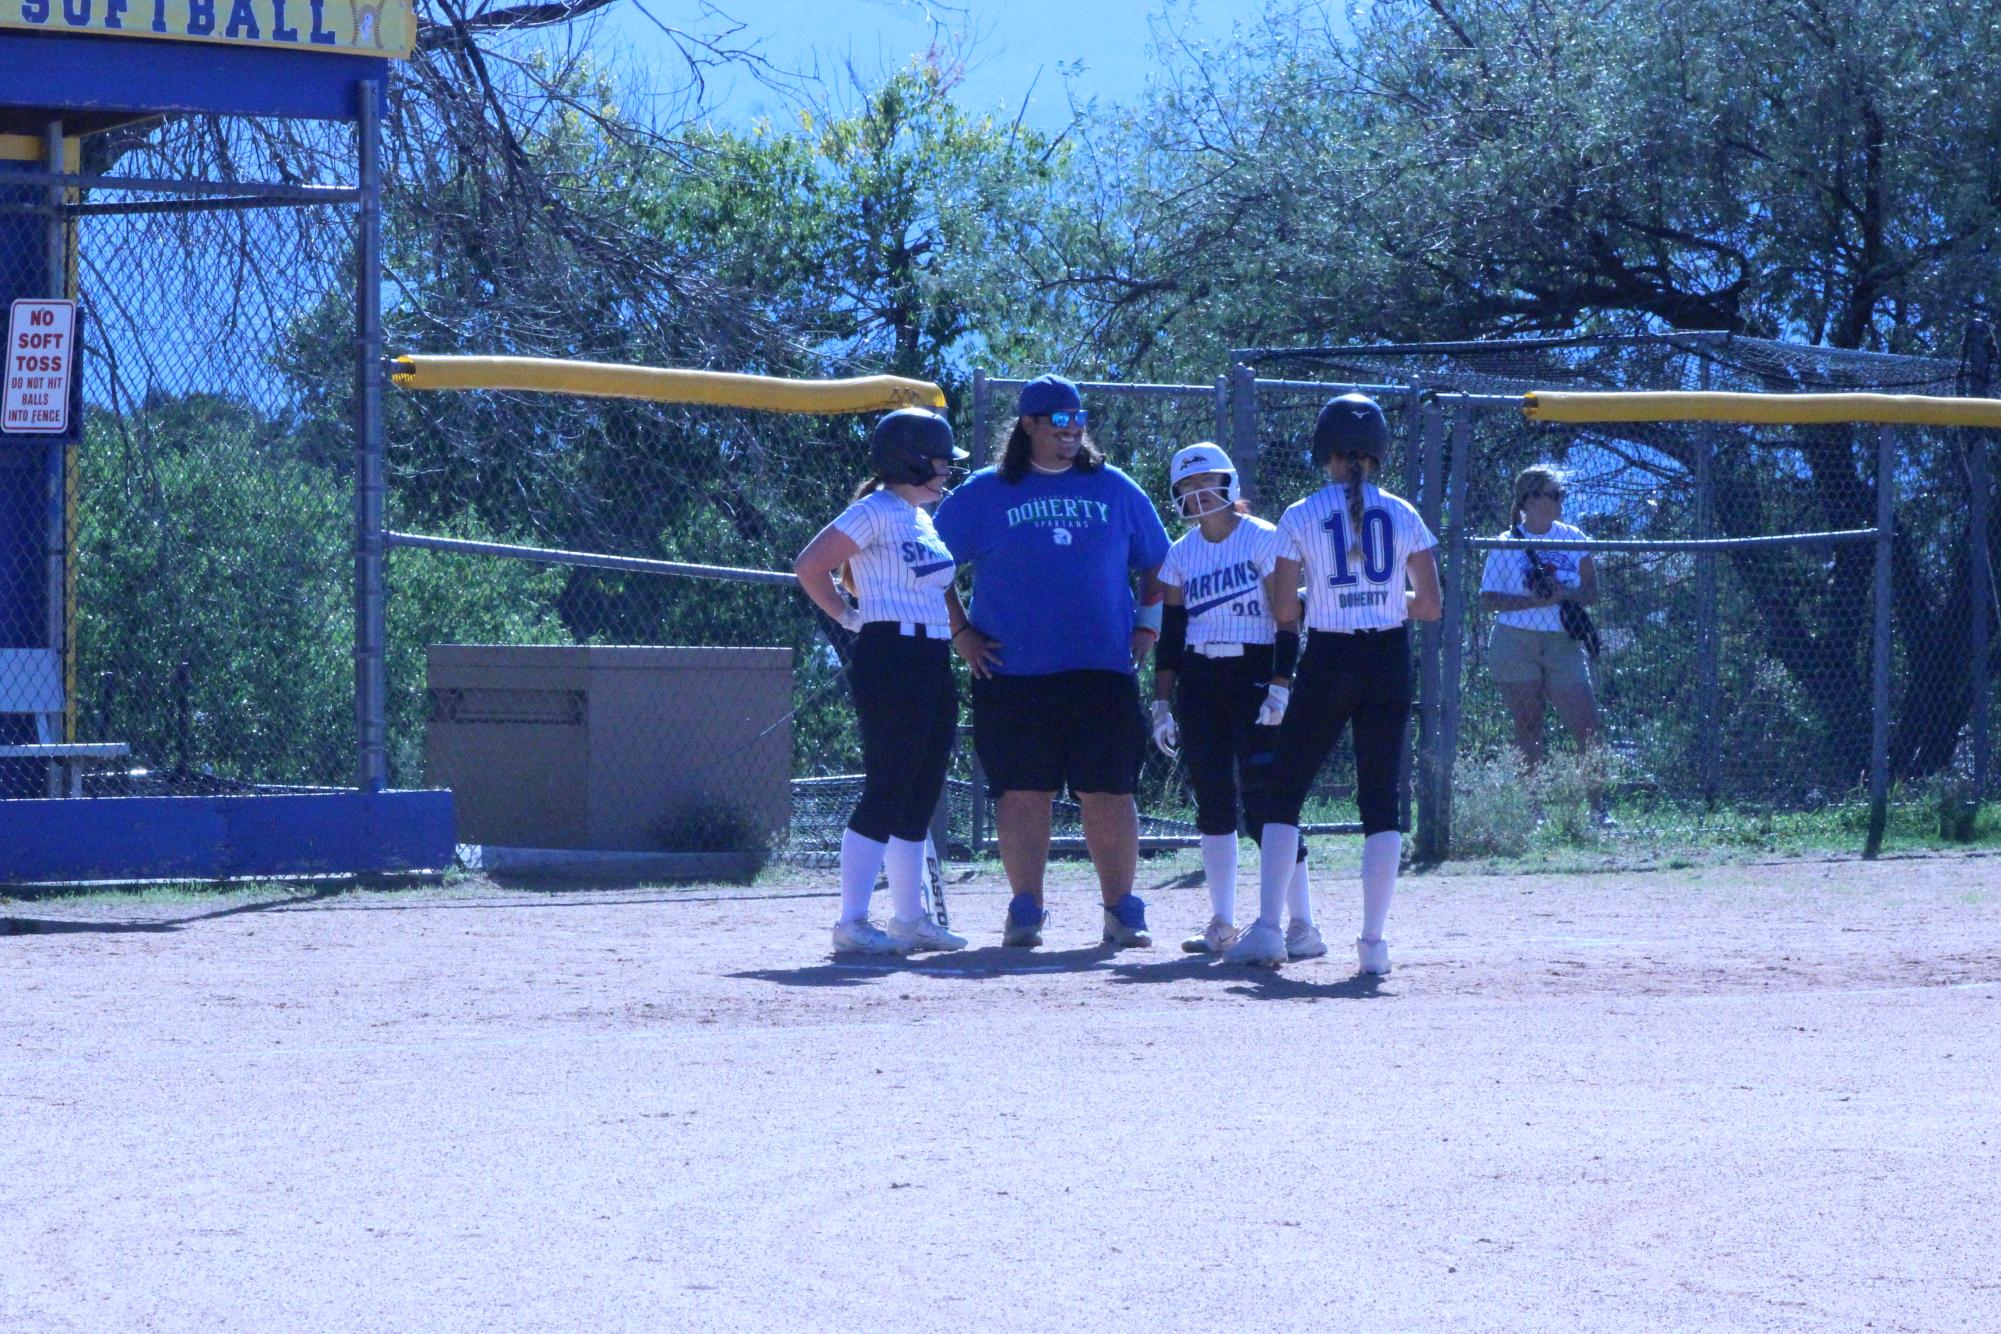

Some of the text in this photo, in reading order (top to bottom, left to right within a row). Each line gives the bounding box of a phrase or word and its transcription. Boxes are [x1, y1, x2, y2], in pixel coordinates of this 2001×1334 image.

[30, 310, 55, 326] NO
[18, 333, 64, 349] SOFT
[15, 355, 62, 372] TOSS
[11, 377, 63, 389] DO NOT HIT
[21, 393, 49, 406] BALLS
[8, 410, 61, 422] INTO FENCE
[1005, 498, 1109, 527] DOHERTY
[1321, 506, 1397, 588] 10
[1183, 559, 1260, 602] PARTANS
[1339, 590, 1389, 609] DOHERTY
[925, 857, 949, 931] EASTO
